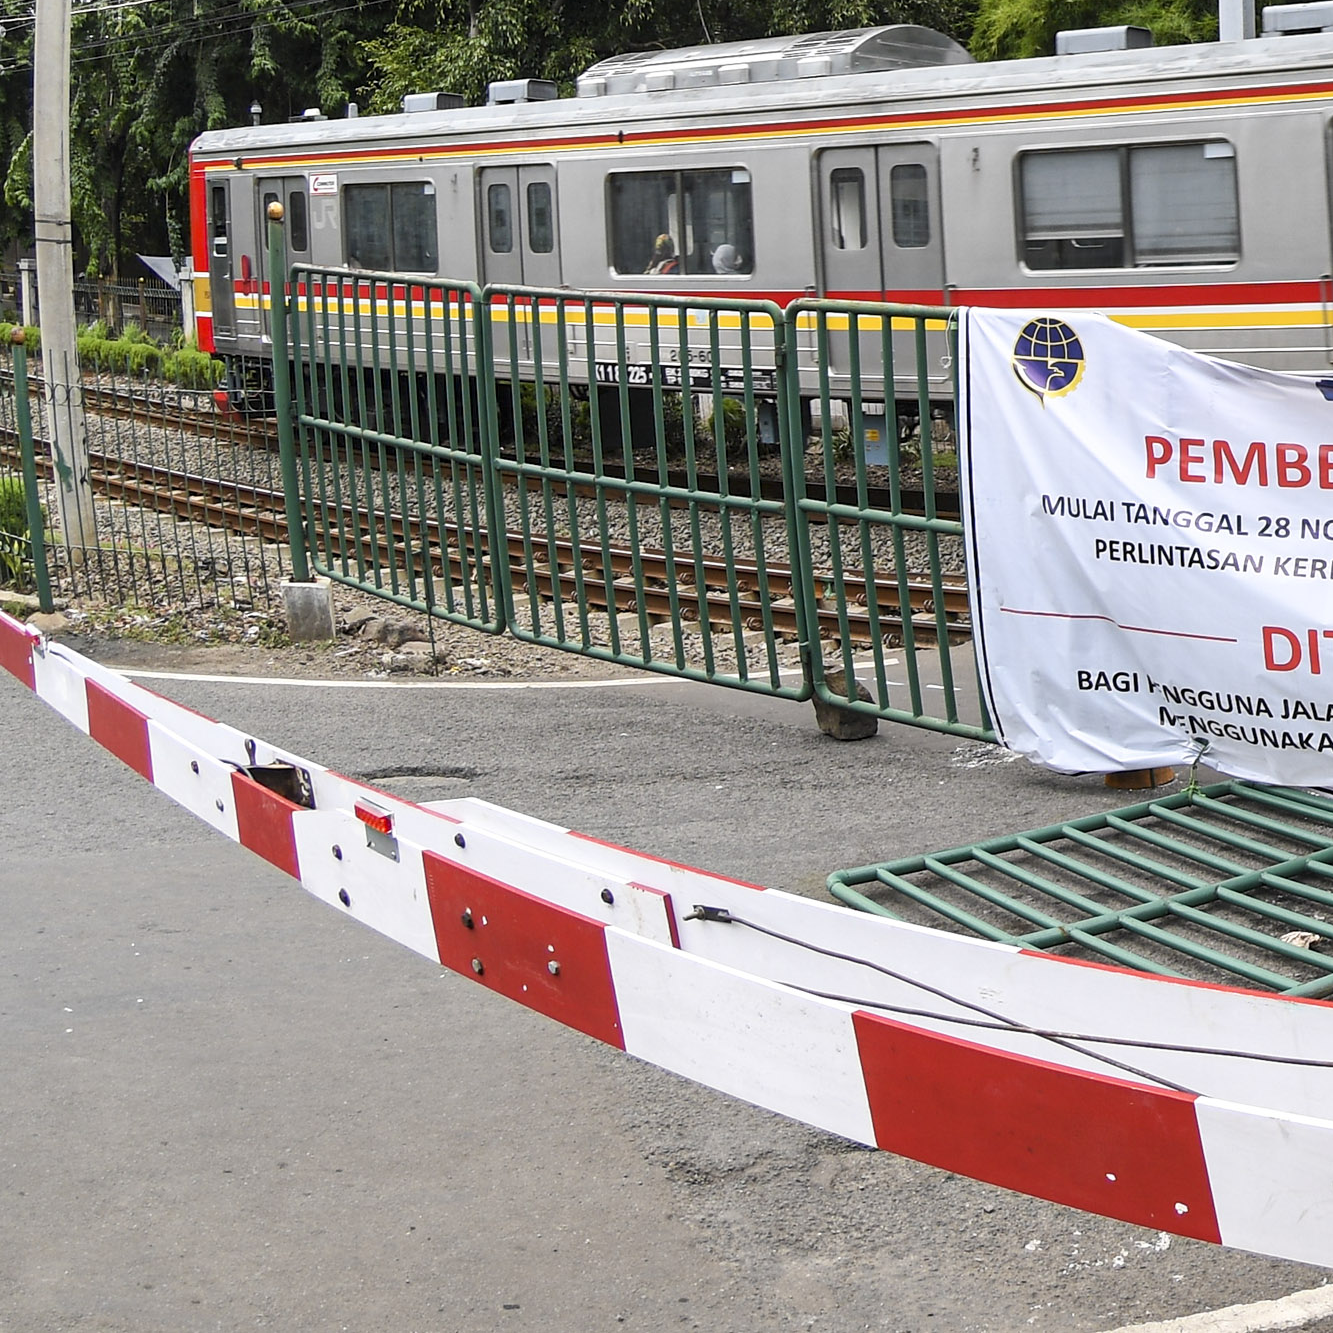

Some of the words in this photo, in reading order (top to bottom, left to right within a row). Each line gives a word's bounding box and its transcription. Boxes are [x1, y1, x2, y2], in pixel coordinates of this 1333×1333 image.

[313, 199, 337, 229] JR
[1041, 494, 1116, 522] MULAI
[1121, 501, 1249, 536] TANGGAL
[1256, 515, 1291, 538] 28
[1095, 538, 1264, 574] PERLINTASAN
[1077, 670, 1140, 693] BAGI
[1146, 673, 1274, 718] NGGUNA
